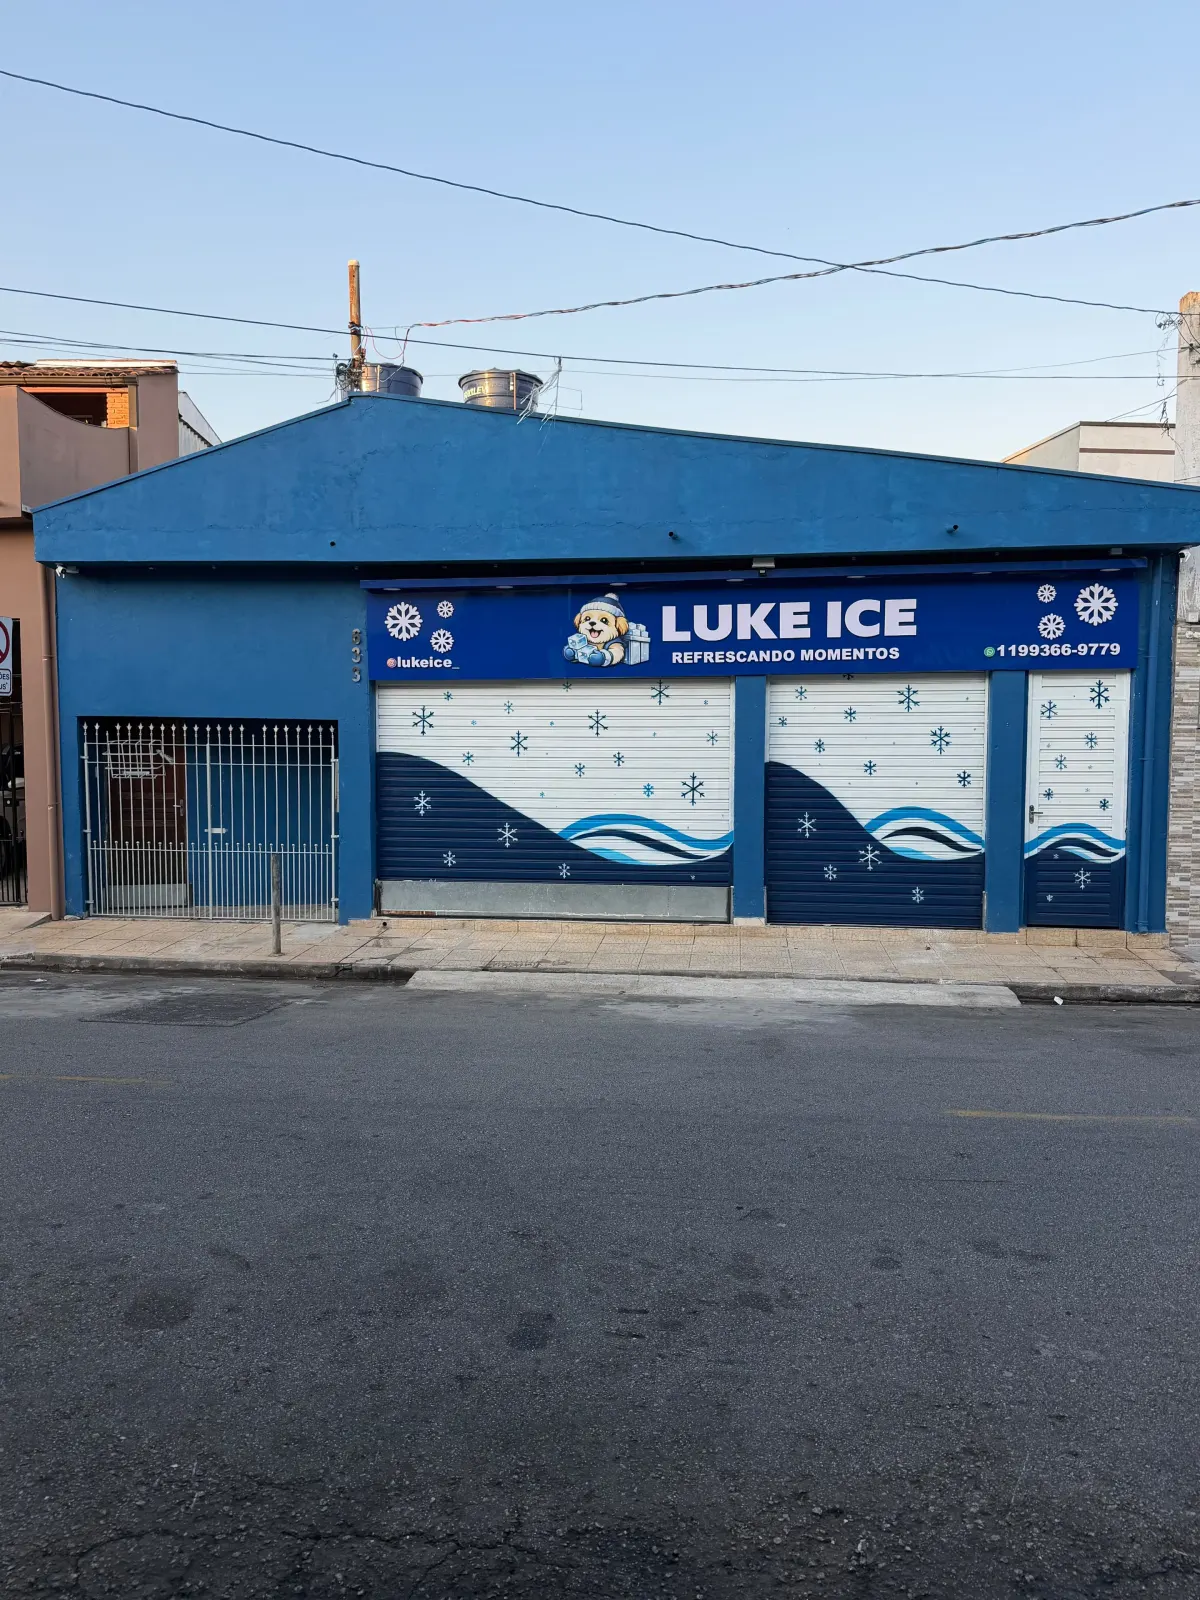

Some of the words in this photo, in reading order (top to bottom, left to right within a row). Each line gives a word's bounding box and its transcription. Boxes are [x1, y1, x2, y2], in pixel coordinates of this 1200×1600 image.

[662, 601, 811, 641] LUKE
[826, 599, 917, 638] ICE
[351, 628, 361, 682] 633
[672, 651, 795, 664] REFRESCANDO
[800, 647, 900, 662] MOMENTOS
[997, 643, 1120, 656] 1199366-9779
